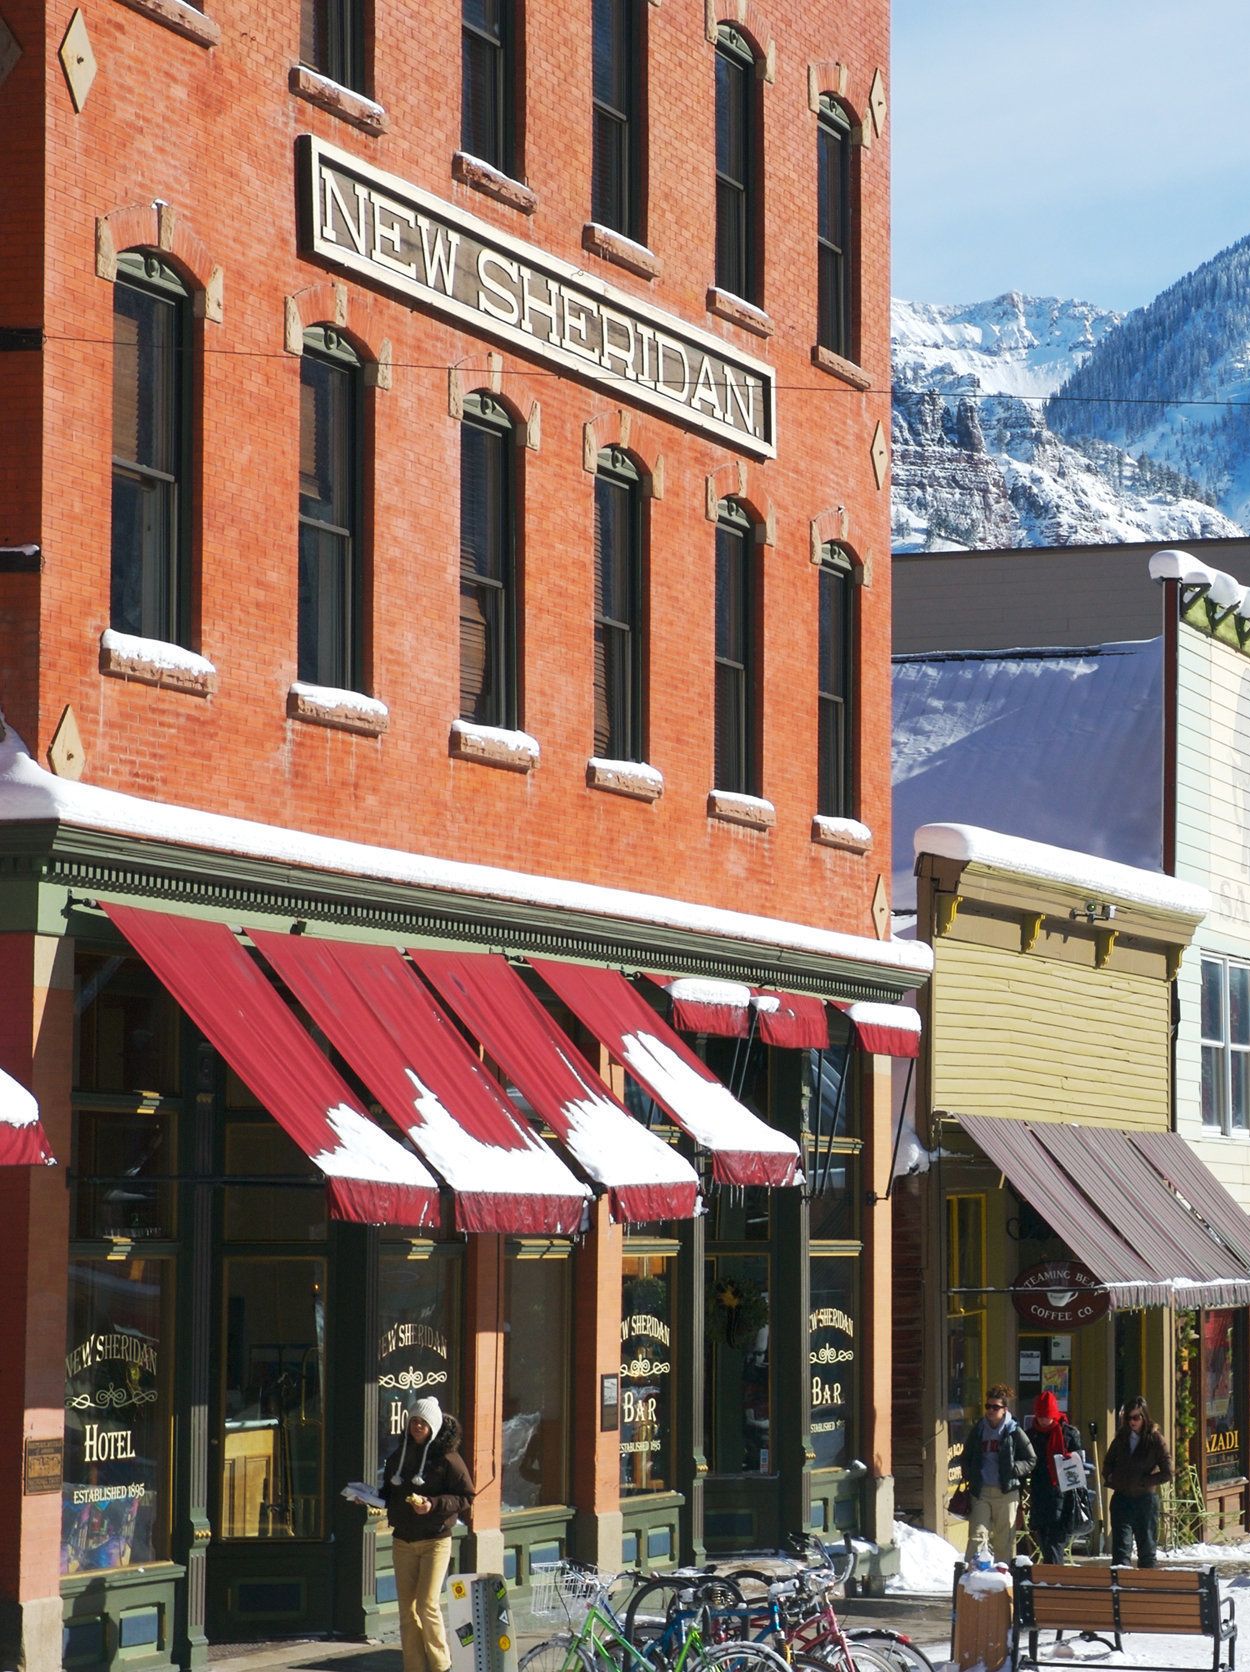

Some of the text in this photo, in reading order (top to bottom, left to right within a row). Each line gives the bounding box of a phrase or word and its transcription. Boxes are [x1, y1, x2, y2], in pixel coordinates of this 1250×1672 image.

[320, 167, 460, 297] NEW
[1024, 1270, 1096, 1289] TEAMING BEA
[819, 1308, 854, 1338] SHERIDAN
[1030, 1304, 1073, 1321] COFFEE
[379, 1322, 448, 1360] EW SHERIDAN
[631, 1314, 670, 1347] SHERIDAN
[65, 1333, 158, 1378] NEW SHERIDAN
[810, 1421, 836, 1434] STABLISHED
[73, 1481, 145, 1505] ESTABLISHED 1895
